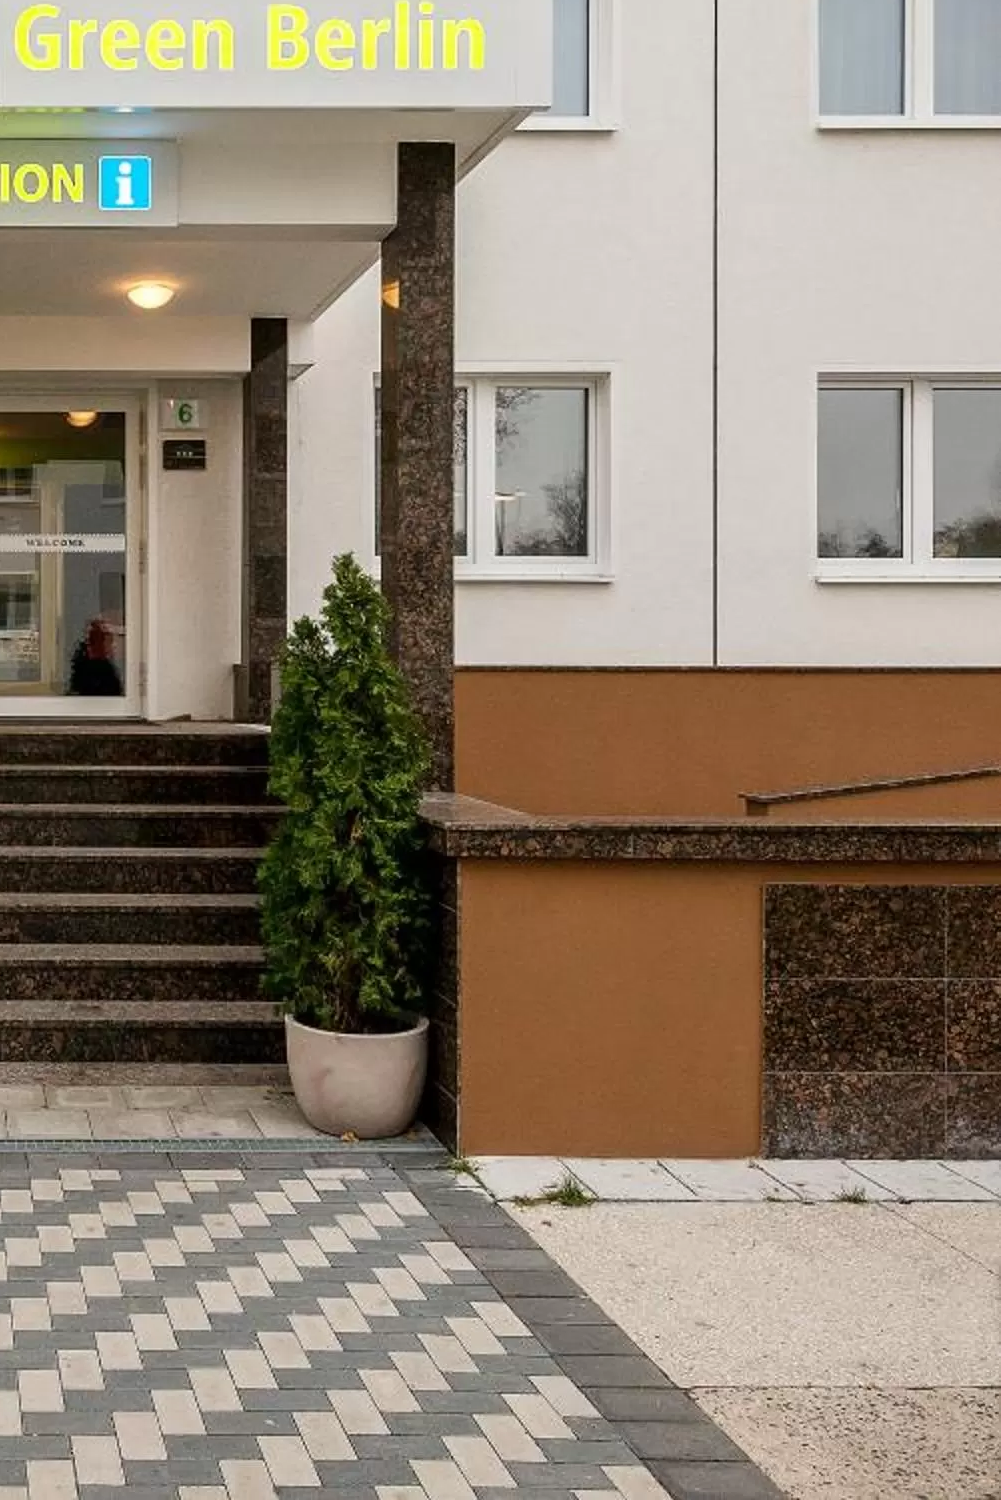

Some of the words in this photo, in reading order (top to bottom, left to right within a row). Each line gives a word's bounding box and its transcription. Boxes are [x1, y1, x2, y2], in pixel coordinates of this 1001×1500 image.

[13, 2, 235, 71] Green
[265, 0, 487, 71] Berlin
[178, 403, 193, 424] 6
